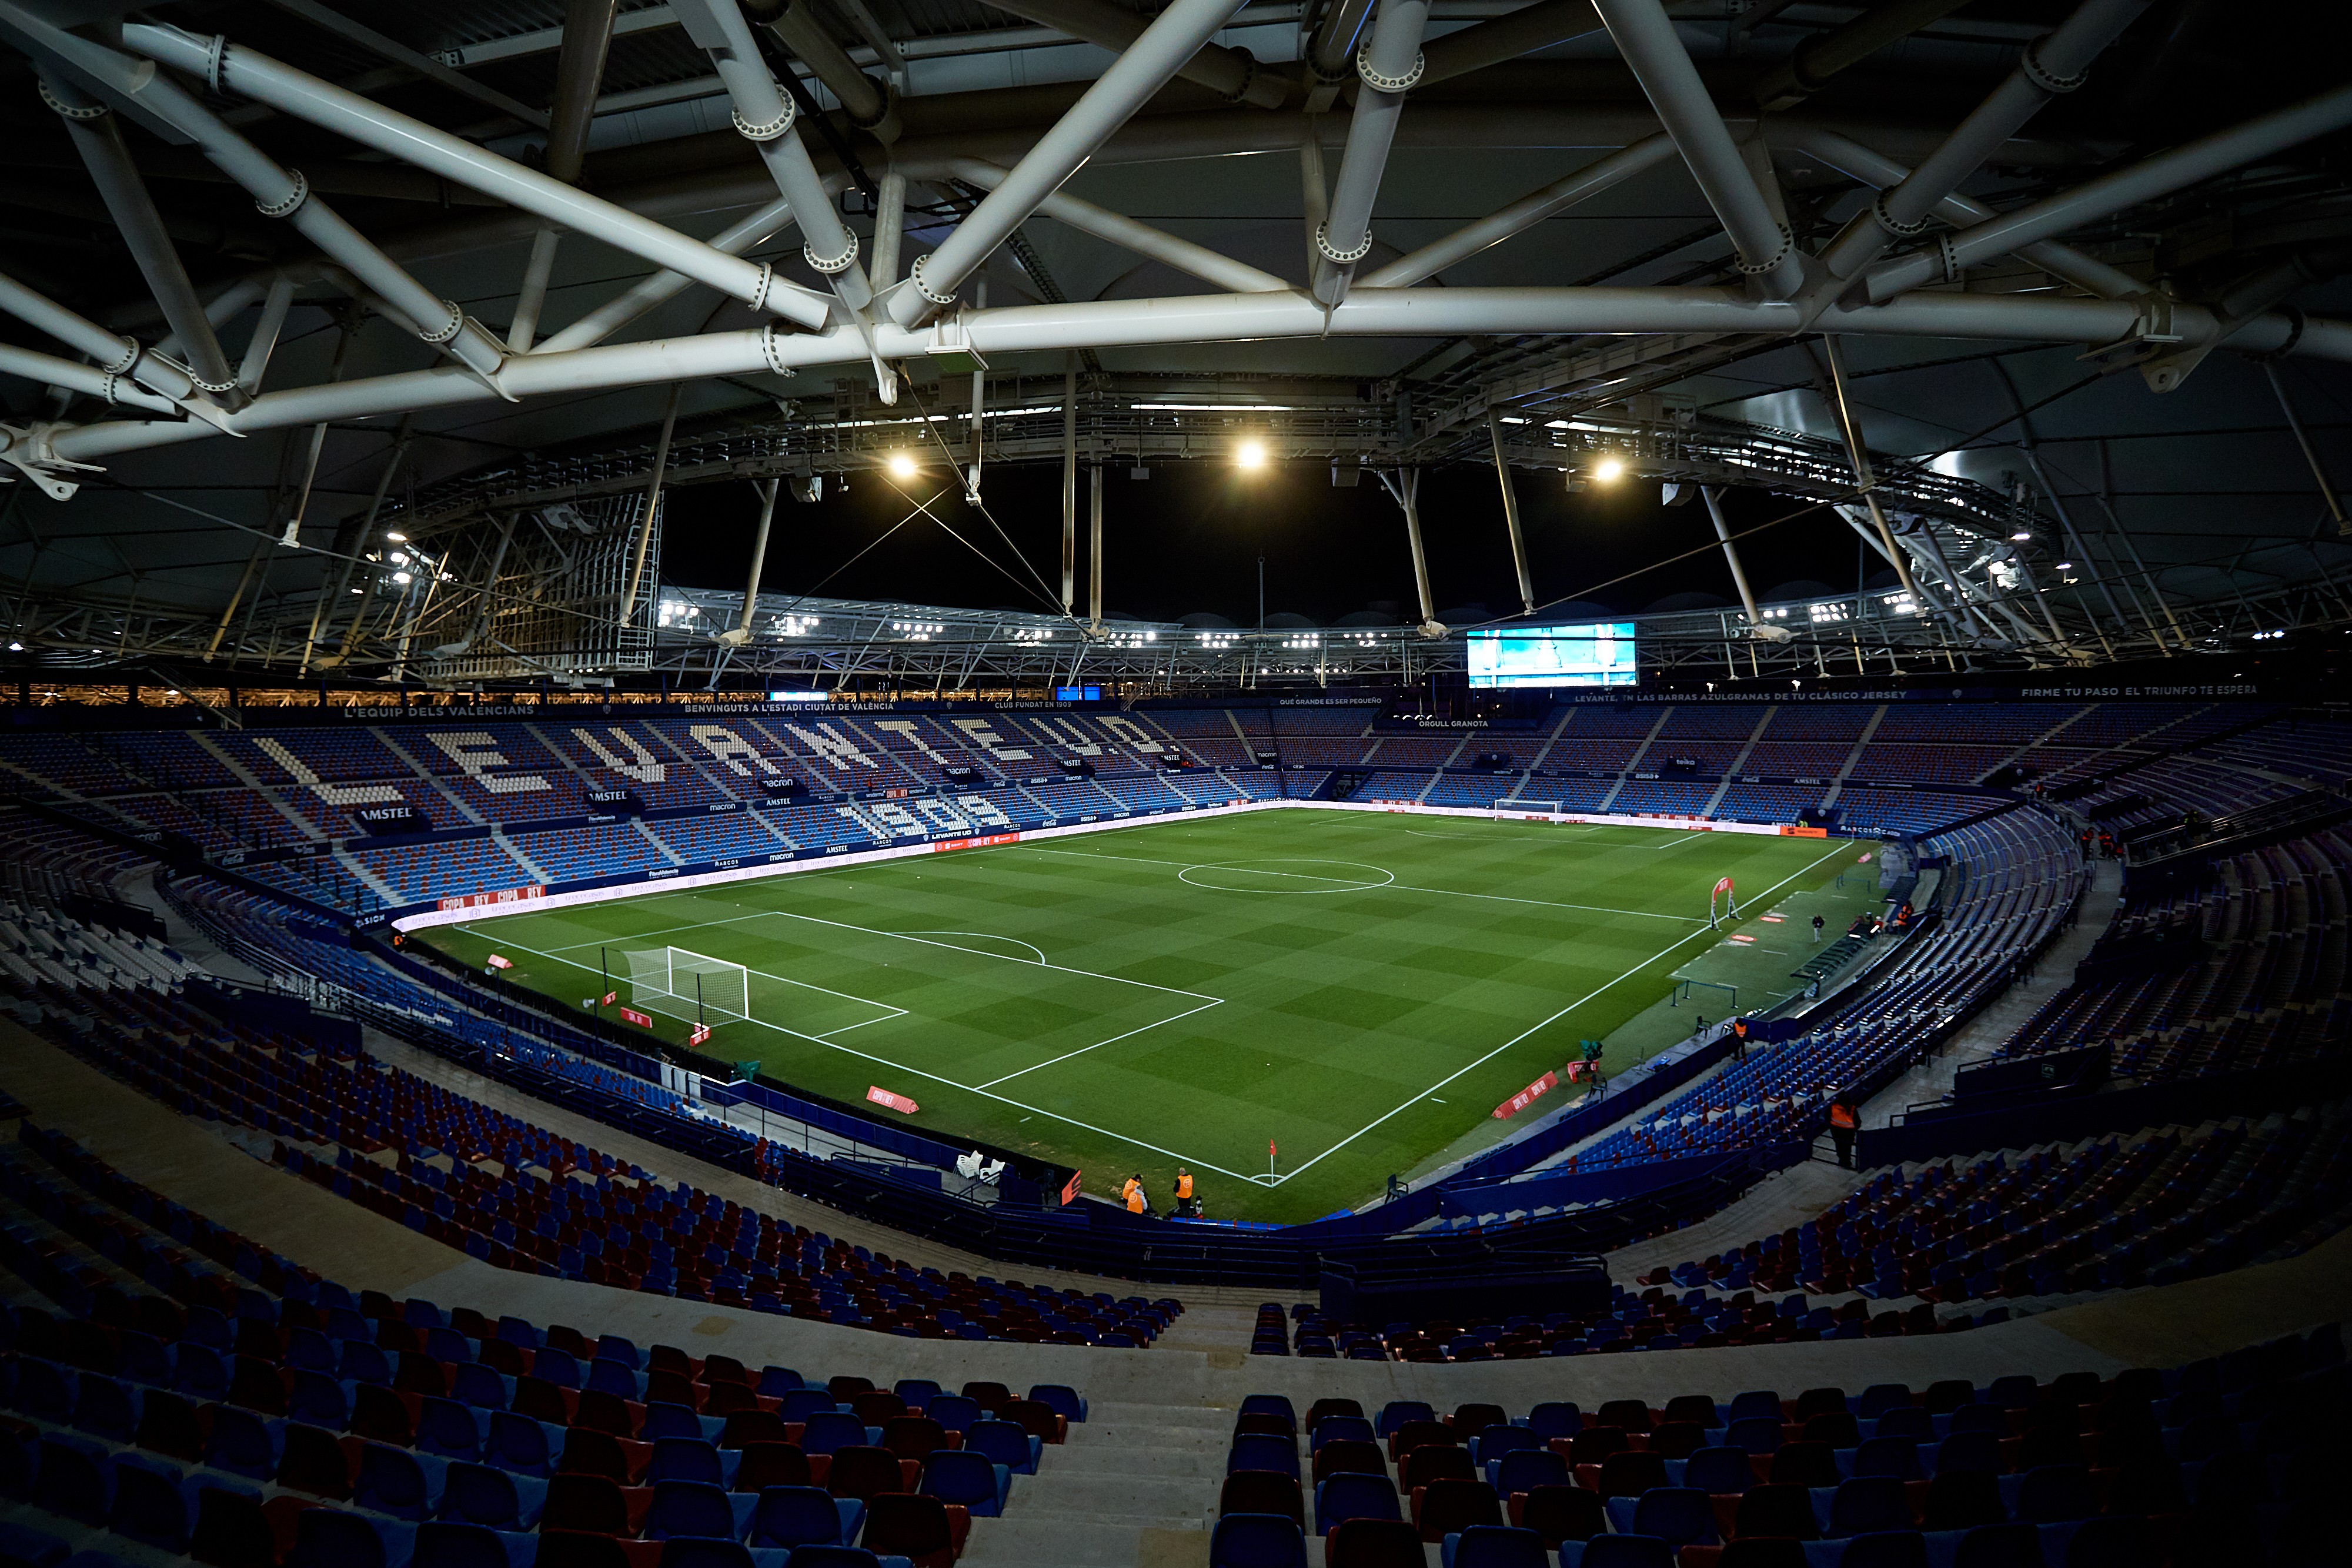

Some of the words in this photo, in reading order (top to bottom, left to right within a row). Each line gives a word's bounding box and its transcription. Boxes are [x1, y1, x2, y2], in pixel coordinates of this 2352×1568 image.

[1700, 693, 1771, 701] AZULGRANAS
[1791, 692, 1806, 700] TU
[1809, 690, 1859, 700] CLÁSICO
[1861, 691, 1907, 700] JERSEY
[2022, 688, 2060, 697] FIRME
[2084, 688, 2119, 696] PASO
[2125, 687, 2140, 696] EL
[2144, 686, 2197, 696] TRIUNFO
[2200, 686, 2214, 694] TE
[2216, 685, 2258, 695] ESPERA
[1279, 697, 1295, 705] QUÉ
[1349, 696, 1382, 704] PEQUEÑO
[408, 707, 445, 717] DELS
[448, 706, 534, 716] VALENCIANS
[685, 704, 749, 713] BENVINGUTS
[751, 704, 759, 712] A
[804, 703, 836, 711] CIUTAT
[852, 701, 894, 711] VALÈNCIA
[1419, 720, 1449, 728] ORGULL
[766, 798, 791, 806] AMSTEL
[931, 831, 961, 839] LEVANTE
[770, 852, 794, 861] macron
[826, 845, 848, 854] AMSTEL
[443, 898, 465, 911] COPA
[475, 894, 489, 906] REY
[497, 890, 519, 903] COPA
[527, 886, 542, 899] REY
